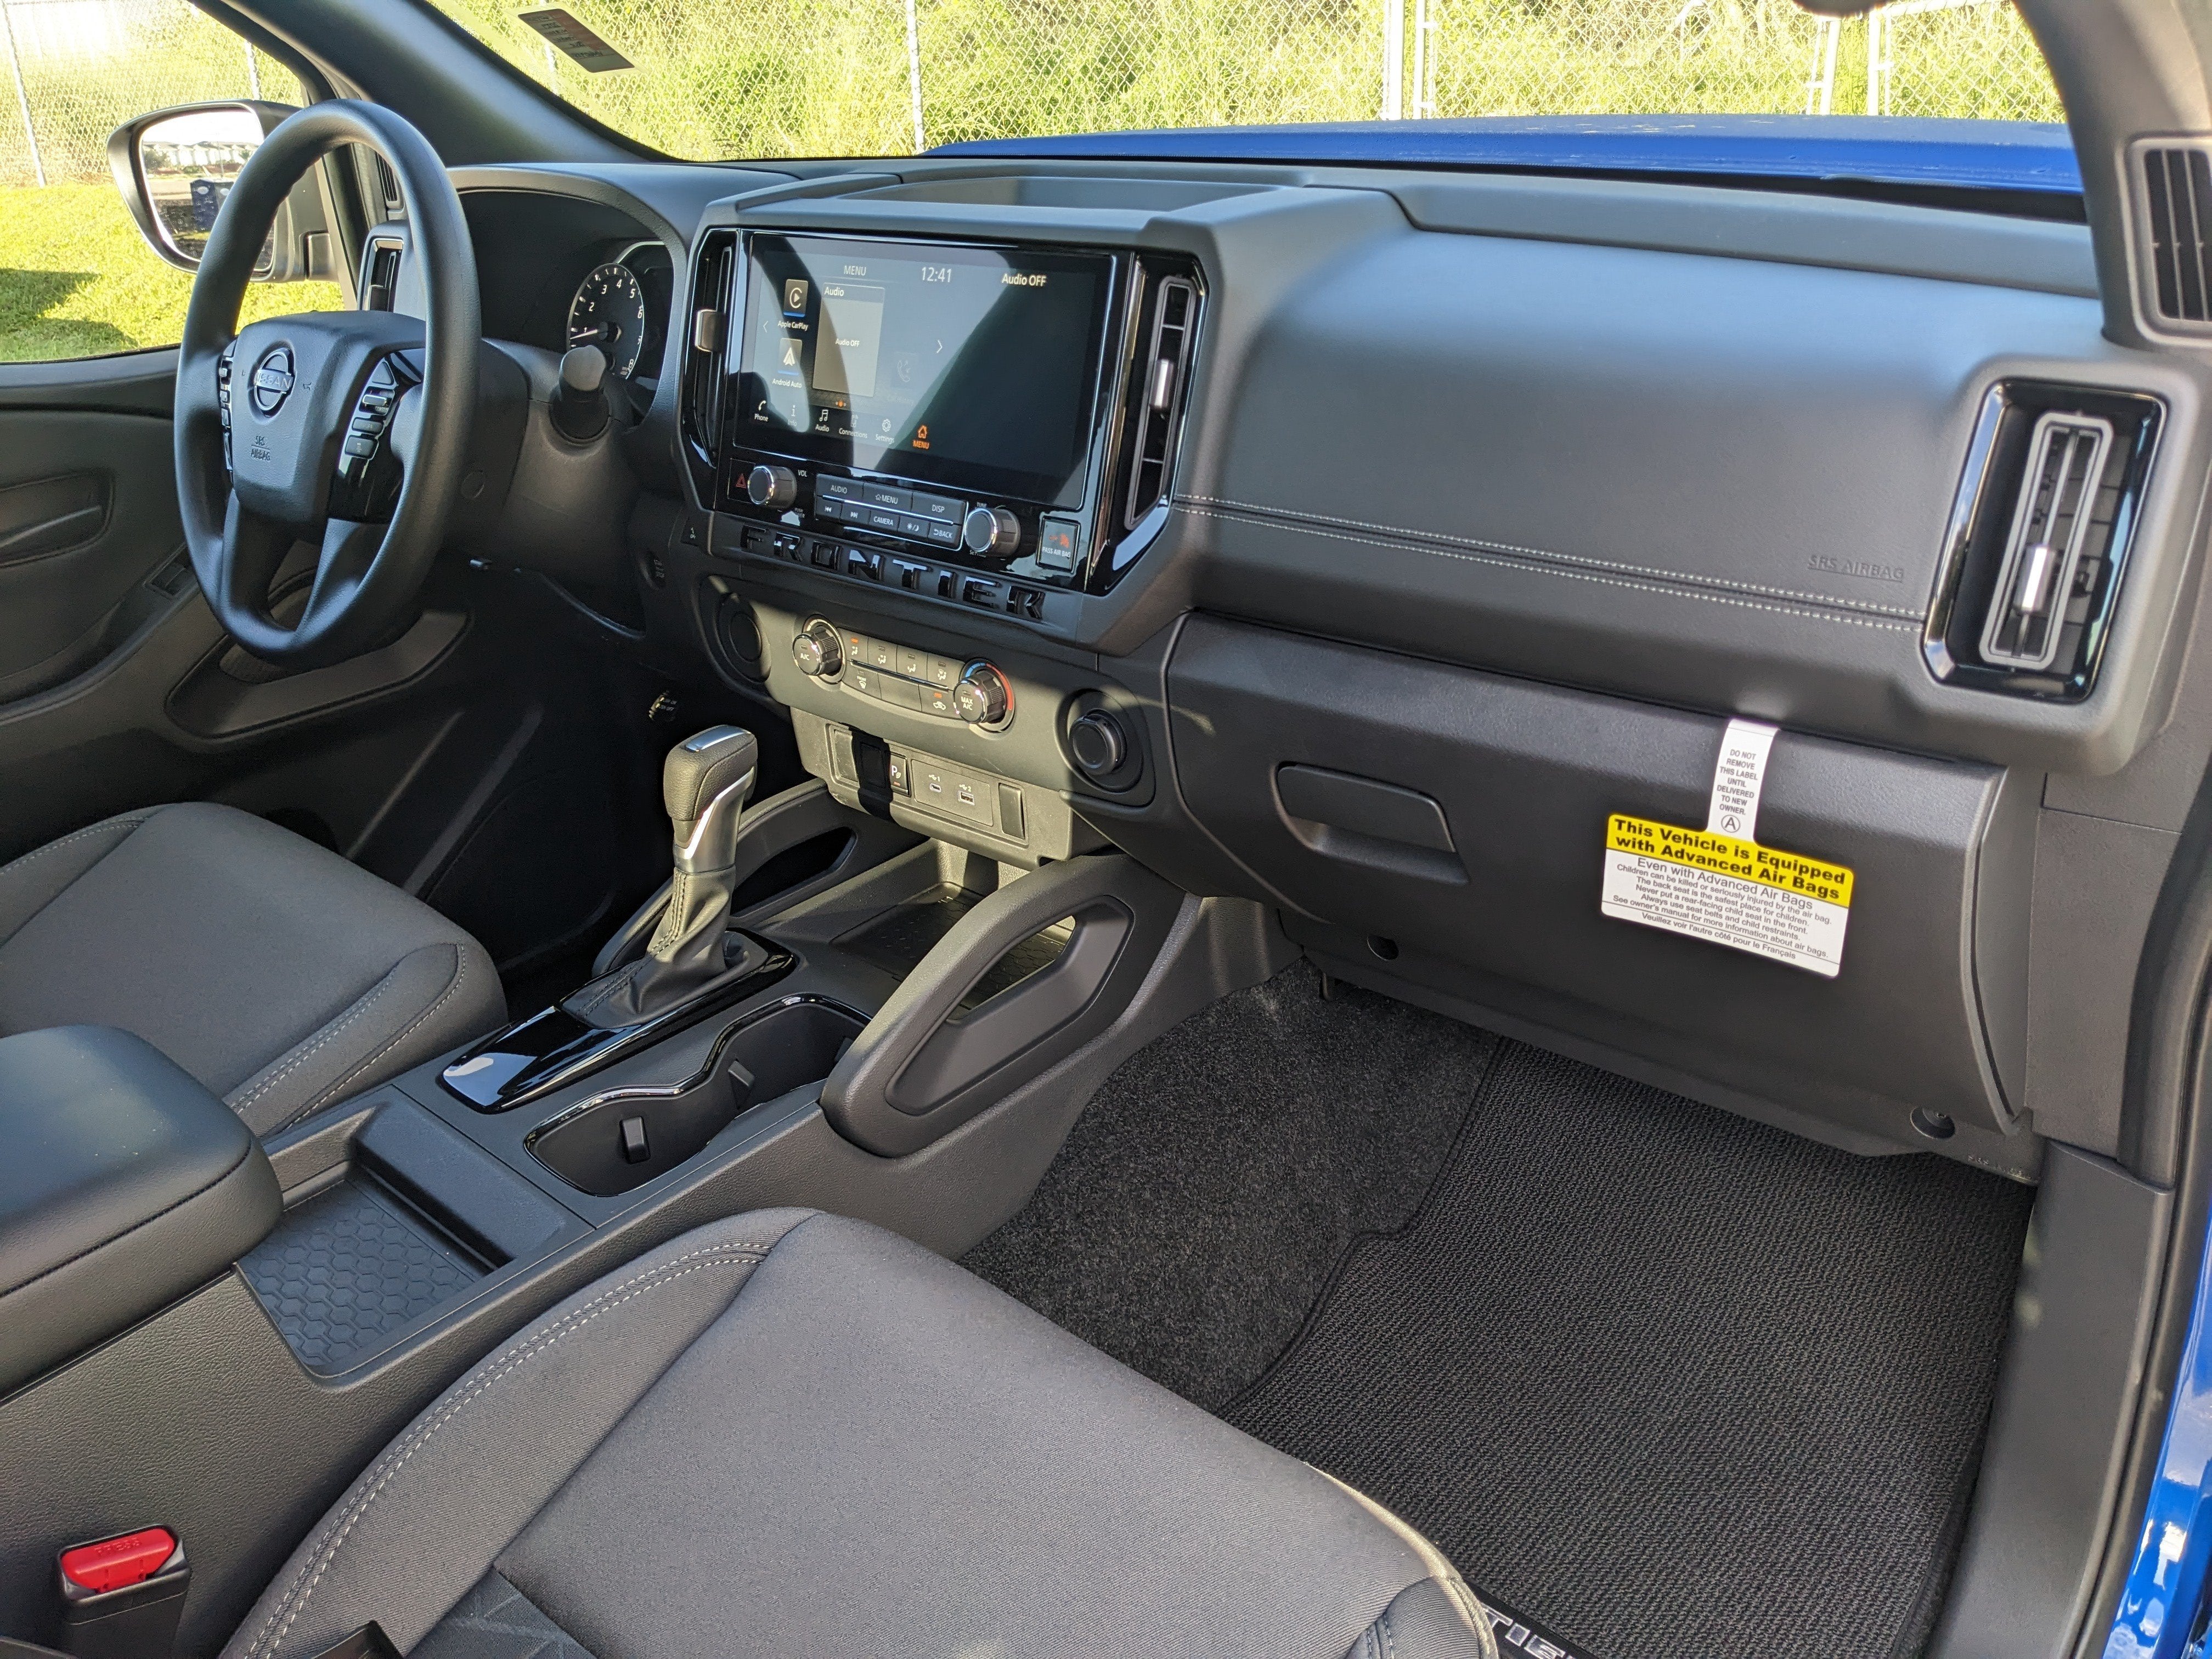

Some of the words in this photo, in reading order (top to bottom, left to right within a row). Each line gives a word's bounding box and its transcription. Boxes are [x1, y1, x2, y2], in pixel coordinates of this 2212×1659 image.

[844, 265, 866, 276] MENU
[922, 267, 952, 283] 12:41
[616, 279, 622, 289] 4
[1001, 273, 1027, 285] Audio
[1029, 275, 1047, 287] OFF
[601, 285, 607, 295] 3
[630, 289, 636, 298] 5
[825, 286, 844, 297] Audio
[589, 302, 594, 312] 2
[637, 309, 642, 319] 6
[777, 320, 791, 329] Apple
[792, 322, 809, 331] CarPlay
[835, 338, 849, 346] Audio
[628, 359, 634, 368] 8
[254, 372, 292, 390] ISSAN
[772, 378, 790, 387] Android
[754, 413, 769, 422] Phone
[815, 424, 830, 432] Audio
[839, 428, 868, 439] Connections
[876, 433, 895, 444] Settings
[913, 439, 930, 449] MENU
[830, 484, 848, 494] AUDIO
[881, 495, 899, 505] MENU
[932, 504, 945, 514] DISP
[873, 516, 894, 526] CAMERA
[939, 531, 953, 539] BACK
[1042, 546, 1053, 555] PASS
[740, 523, 1046, 619] FRONTIER
[1808, 554, 1837, 569] SRS
[1841, 558, 1904, 579] AIRBAG
[800, 653, 810, 661] A/C
[961, 696, 973, 705] MAX
[1730, 749, 1741, 757] DO
[1741, 751, 1756, 760] NOT
[1726, 758, 1756, 770] REMOVE
[1719, 766, 1735, 776] THIS
[1736, 769, 1758, 781] LABEL
[1727, 777, 1746, 788] UNTIL
[1717, 785, 1754, 799] DELIVERED
[1721, 794, 1730, 803] TO
[1731, 797, 1748, 806] NEW
[1724, 816, 1736, 831] A
[1614, 819, 1653, 837] This
[1659, 827, 1728, 854] Vehicle
[1734, 845, 1750, 860] is
[1757, 850, 1846, 885] Equipped
[1616, 837, 1655, 853] with
[1661, 845, 1752, 876] Advanced
[1758, 867, 1787, 884] Air
[1792, 876, 1839, 899] Bags
[1638, 857, 1667, 872] Even
[1671, 866, 1695, 879] with
[1697, 872, 1758, 894] Advanced
[1760, 887, 1778, 900] Air
[1782, 893, 1813, 910] Bags
[1617, 864, 1649, 877] Children
[1650, 872, 1664, 881] can
[1678, 877, 1698, 889] killed
[1710, 886, 1745, 901] seriously
[1747, 895, 1774, 908] injured
[1775, 902, 1785, 912] by
[1787, 906, 1800, 915] the
[1802, 909, 1813, 918] air
[1815, 912, 1832, 925] bag.
[1636, 876, 1651, 885] The
[1653, 880, 1671, 890] back
[1673, 885, 1690, 894] seat
[1700, 891, 1712, 900] the
[1714, 896, 1738, 907] safest
[1740, 902, 1761, 912] place
[1763, 907, 1774, 916] for
[1776, 910, 1809, 927] children.
[1635, 884, 1658, 895] Never
[1660, 890, 1673, 900] put
[1681, 895, 1723, 912] rear-facing
[1724, 906, 1743, 916] child
[1745, 911, 1762, 922] seat
[1764, 916, 1771, 924] in
[1773, 918, 1786, 928] the
[1788, 922, 1808, 935] front.
[1641, 894, 1668, 906] Always
[1686, 904, 1702, 914] seat
[1704, 908, 1723, 919] belts
[1724, 915, 1740, 924] and
[1741, 918, 1760, 929] child
[1762, 924, 1801, 941] restraints.
[1613, 895, 1628, 904] See
[1630, 899, 1659, 911] owner's
[1661, 906, 1689, 918] manual
[1691, 913, 1701, 922] for
[1703, 917, 1724, 928] more
[1725, 922, 1769, 940] information
[1770, 934, 1793, 947] about
[1795, 942, 1805, 951] air
[1807, 944, 1829, 958] bags.
[1641, 912, 1672, 926] Veuillez
[1673, 919, 1688, 929] voir
[1689, 923, 1713, 936] l'autre
[1714, 931, 1731, 941] côté
[1733, 936, 1752, 947] pour
[1753, 941, 1760, 949] le
[1762, 943, 1796, 960] Français
